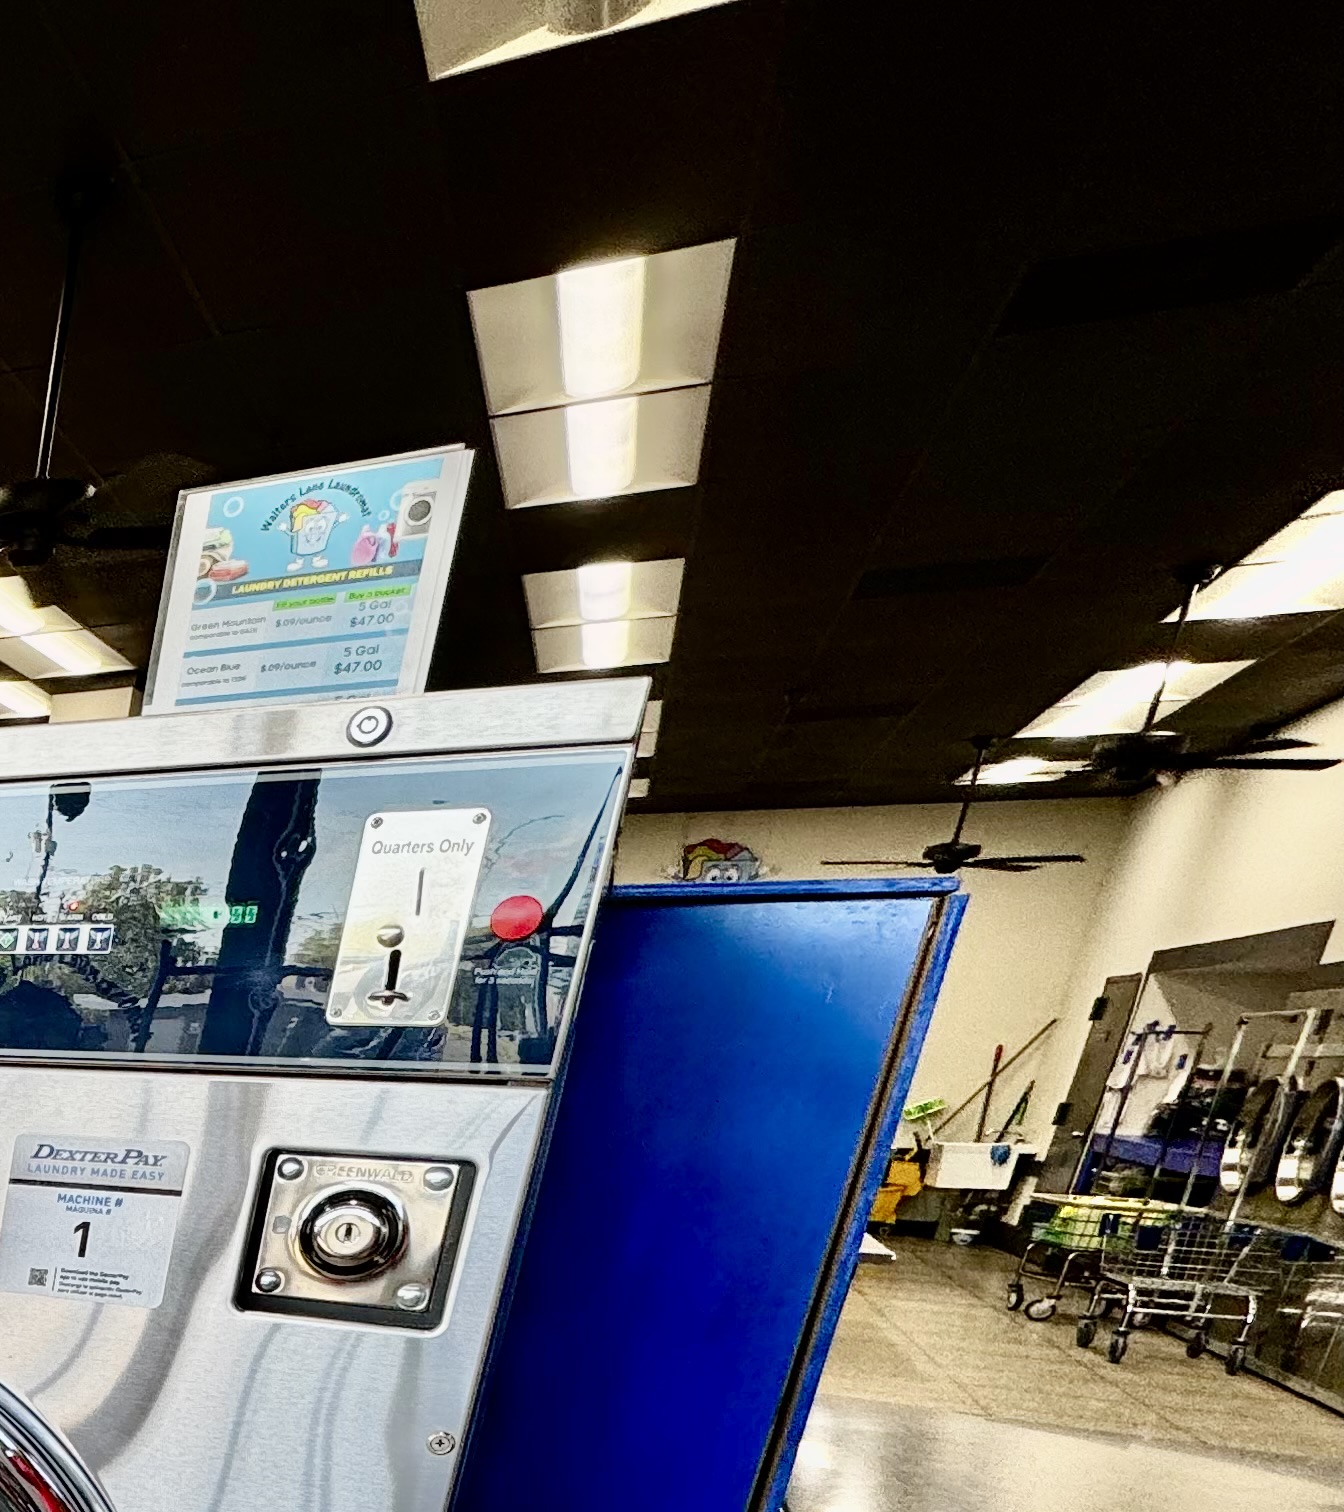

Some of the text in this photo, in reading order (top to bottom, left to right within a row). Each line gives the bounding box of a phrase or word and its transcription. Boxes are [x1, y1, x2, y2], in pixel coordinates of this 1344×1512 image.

[261, 494, 296, 531] Walters
[299, 482, 324, 498] Lane
[232, 565, 394, 595] LAUNDRY DETERGENT REFILLS
[348, 591, 364, 600] Buy
[359, 600, 392, 611] 5 Gal
[191, 621, 220, 632] Green
[222, 616, 267, 628] Mountain
[350, 613, 394, 628] $47.00
[344, 644, 380, 658] 5 Gal
[187, 665, 219, 676] Ocean
[220, 662, 242, 673] Blue
[333, 659, 382, 676] $47.00
[371, 839, 475, 857] Quarters Only
[28, 1163, 165, 1182] LAUNDRY MADE EASY
[314, 1164, 414, 1183] GREENWALD
[57, 1193, 124, 1207] MACHINE #
[73, 1221, 91, 1258] 1
